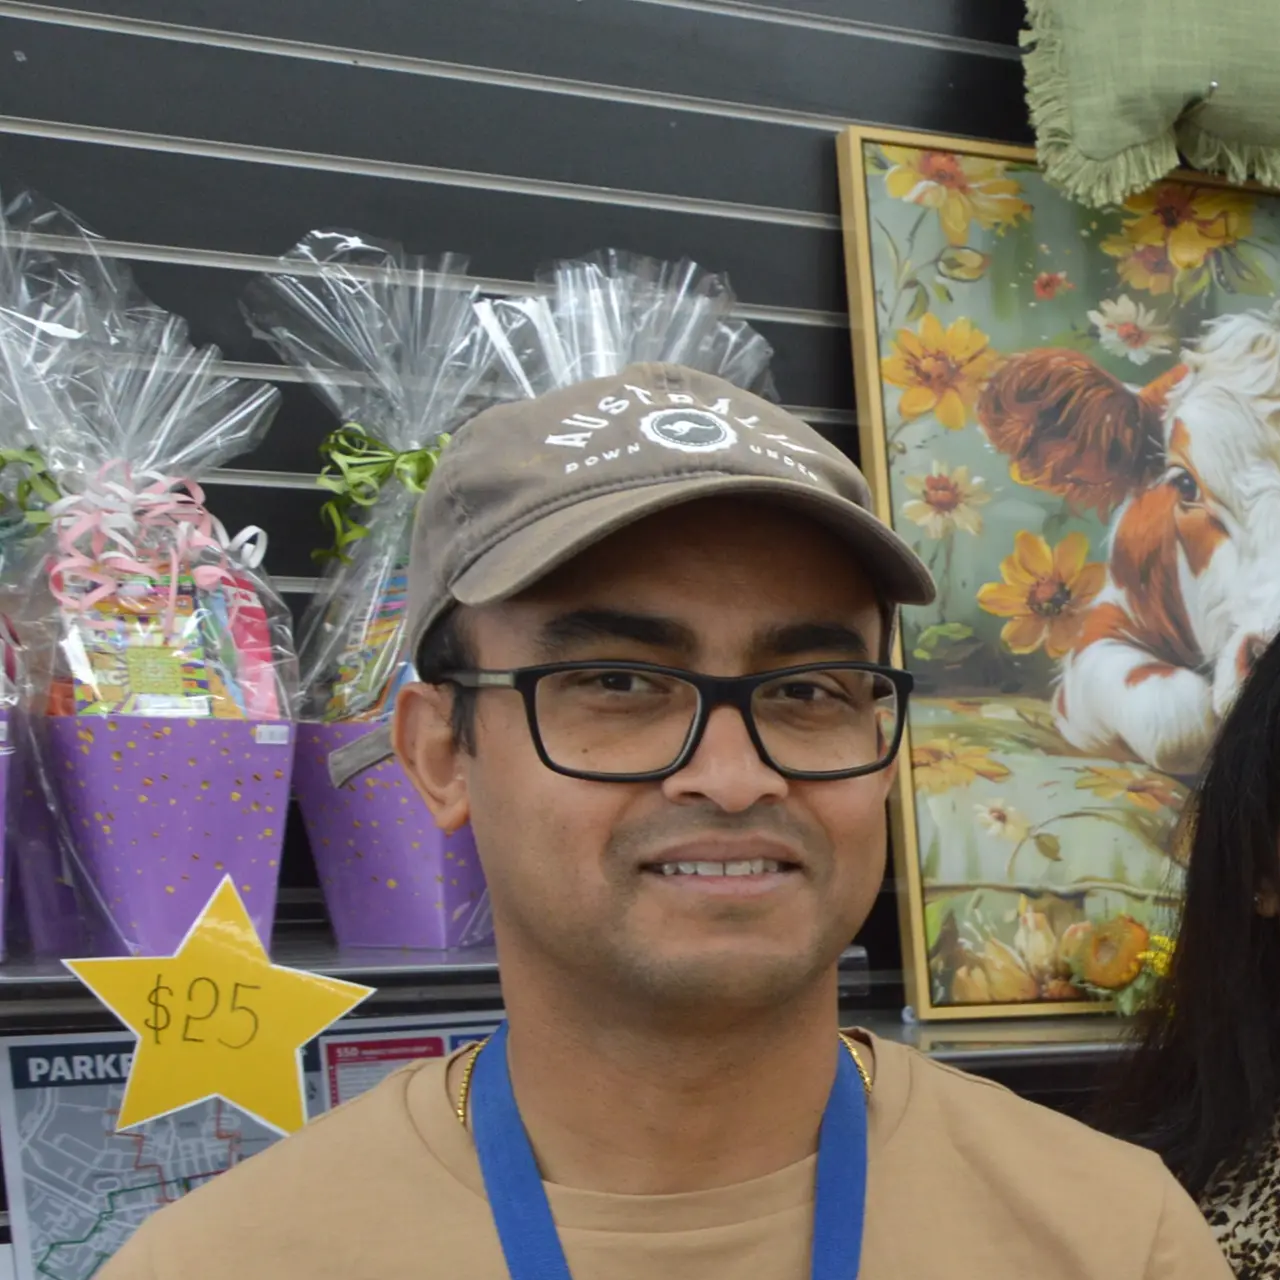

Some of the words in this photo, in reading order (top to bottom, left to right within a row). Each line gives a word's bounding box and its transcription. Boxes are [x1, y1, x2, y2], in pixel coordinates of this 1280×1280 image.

[545, 384, 818, 455] AUSTRALI
[565, 442, 641, 474] DOWN
[144, 974, 261, 1049] $25
